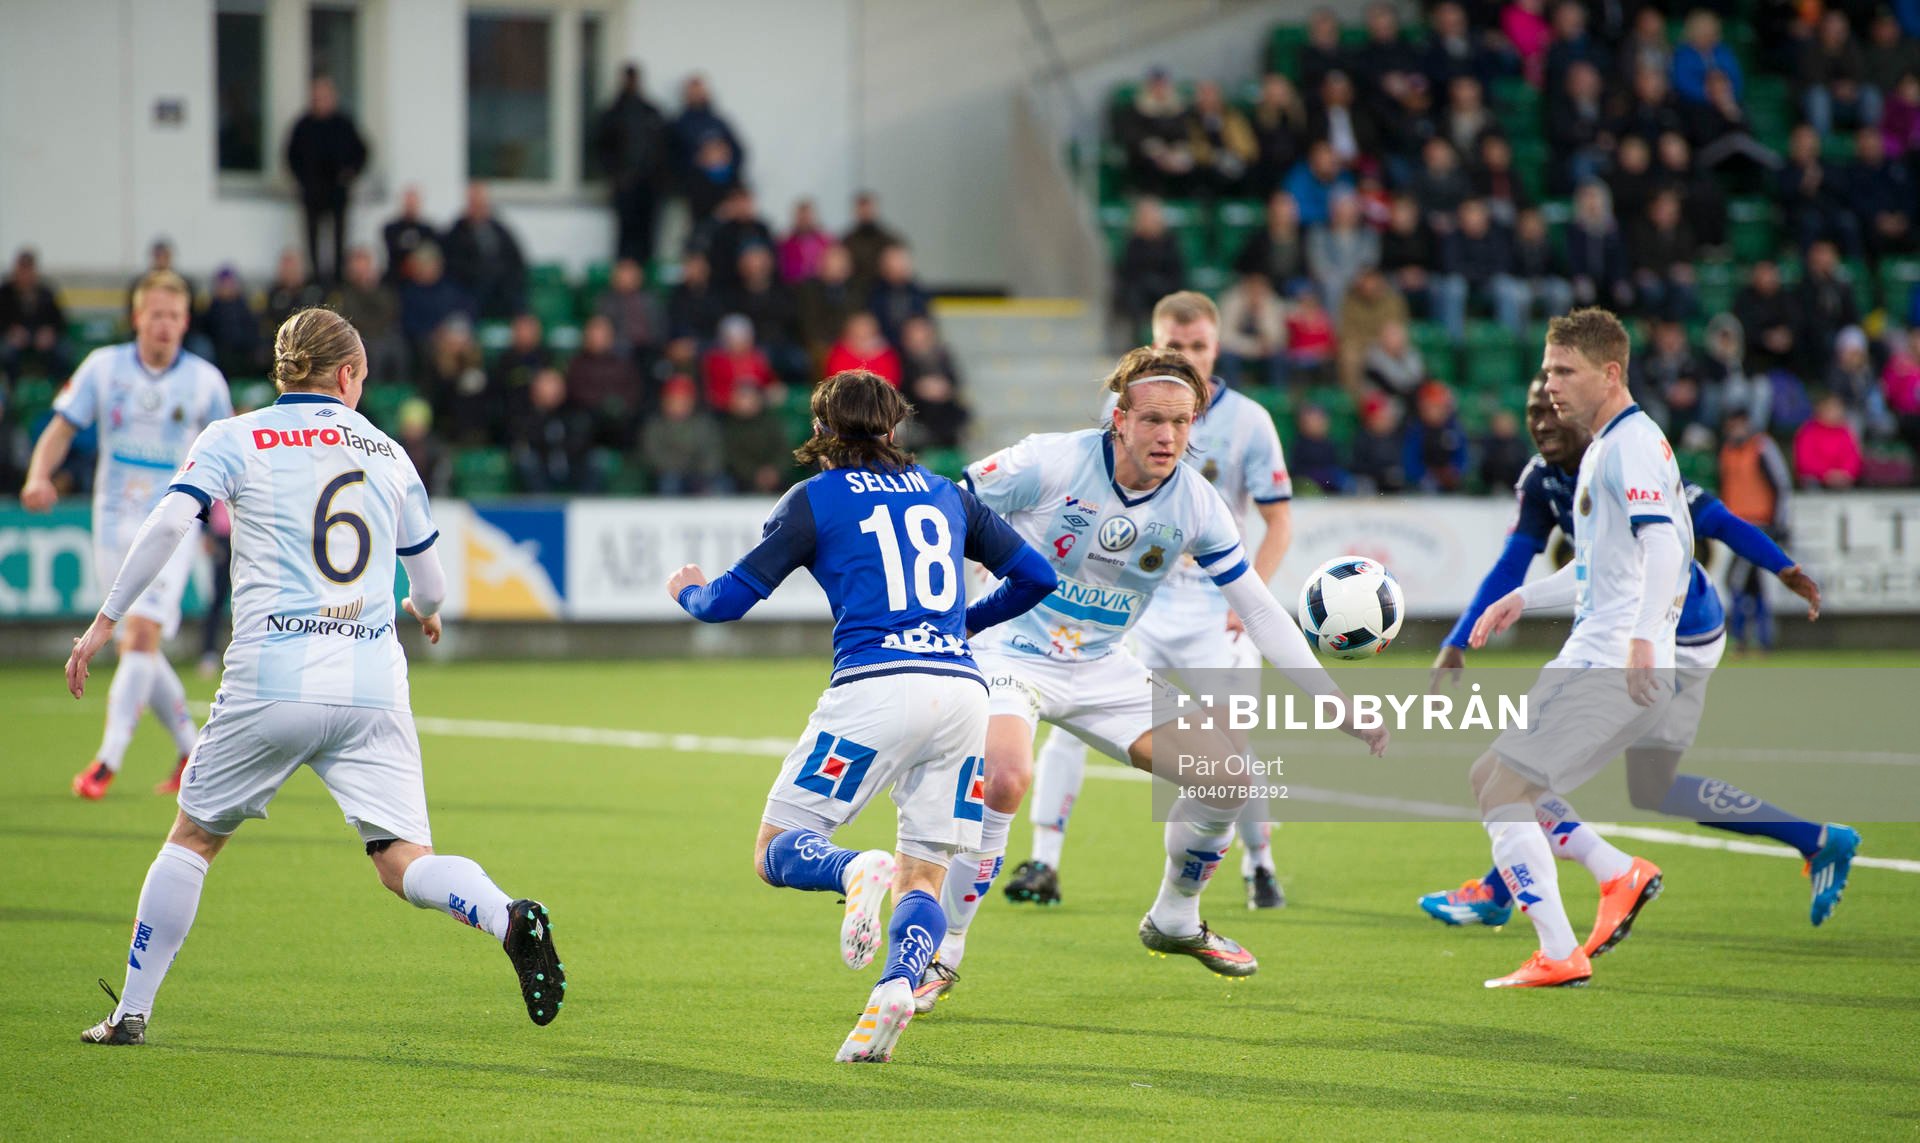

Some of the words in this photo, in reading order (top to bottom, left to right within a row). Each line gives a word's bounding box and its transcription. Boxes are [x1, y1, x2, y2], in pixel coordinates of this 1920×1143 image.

[845, 472, 930, 493] SELLIN
[312, 469, 371, 585] 6
[859, 504, 957, 612] 18
[1057, 580, 1136, 611] ANDVIK
[133, 921, 153, 952] SPORT
